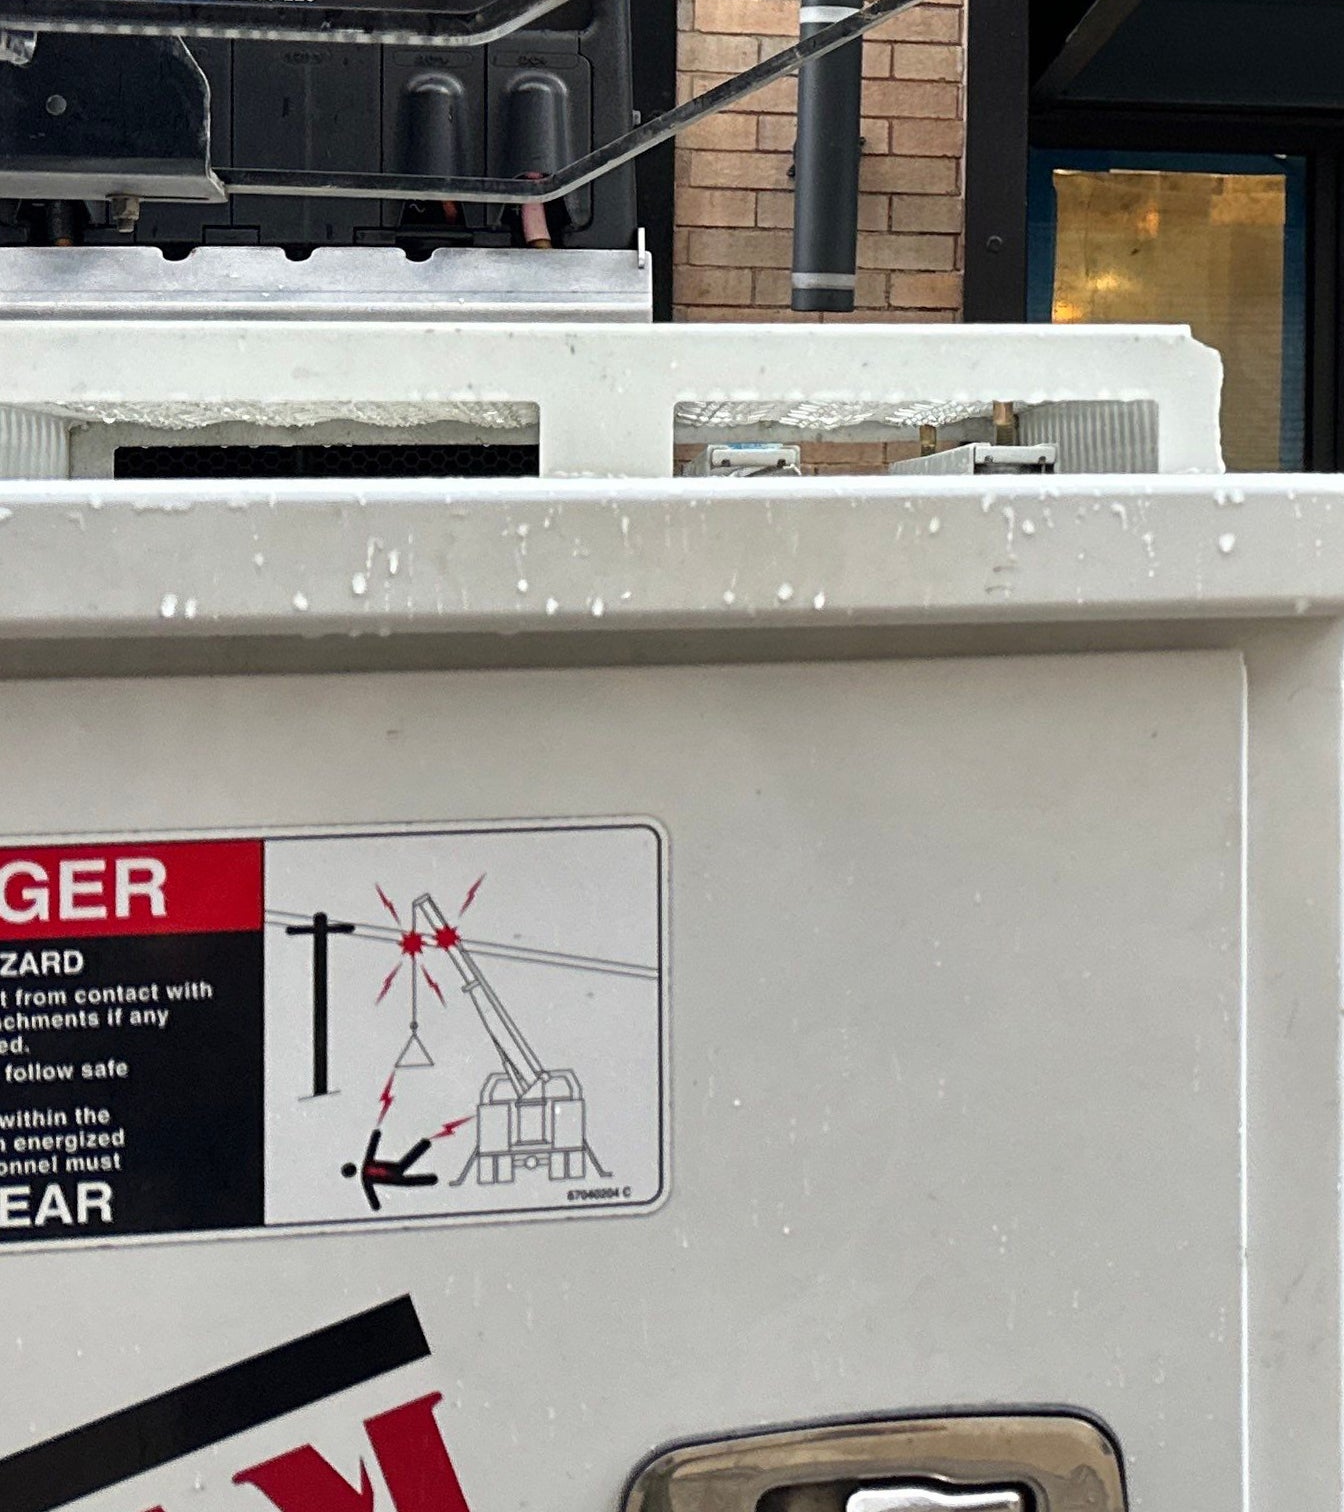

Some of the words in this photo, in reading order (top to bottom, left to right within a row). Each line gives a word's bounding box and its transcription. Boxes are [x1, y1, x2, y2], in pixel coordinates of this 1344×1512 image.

[0, 857, 168, 924] GER
[0, 950, 84, 977] ZARD
[15, 988, 67, 1006] from
[74, 984, 160, 1004] contact
[165, 980, 214, 1000] with
[107, 1007, 123, 1025] if
[129, 1009, 169, 1029] any
[5, 1061, 73, 1083] follow
[81, 1057, 128, 1079] safe
[0, 1107, 67, 1129] within
[75, 1106, 110, 1125] the
[14, 1127, 126, 1153] energized
[66, 1151, 122, 1172] must
[0, 1181, 113, 1228] EAR
